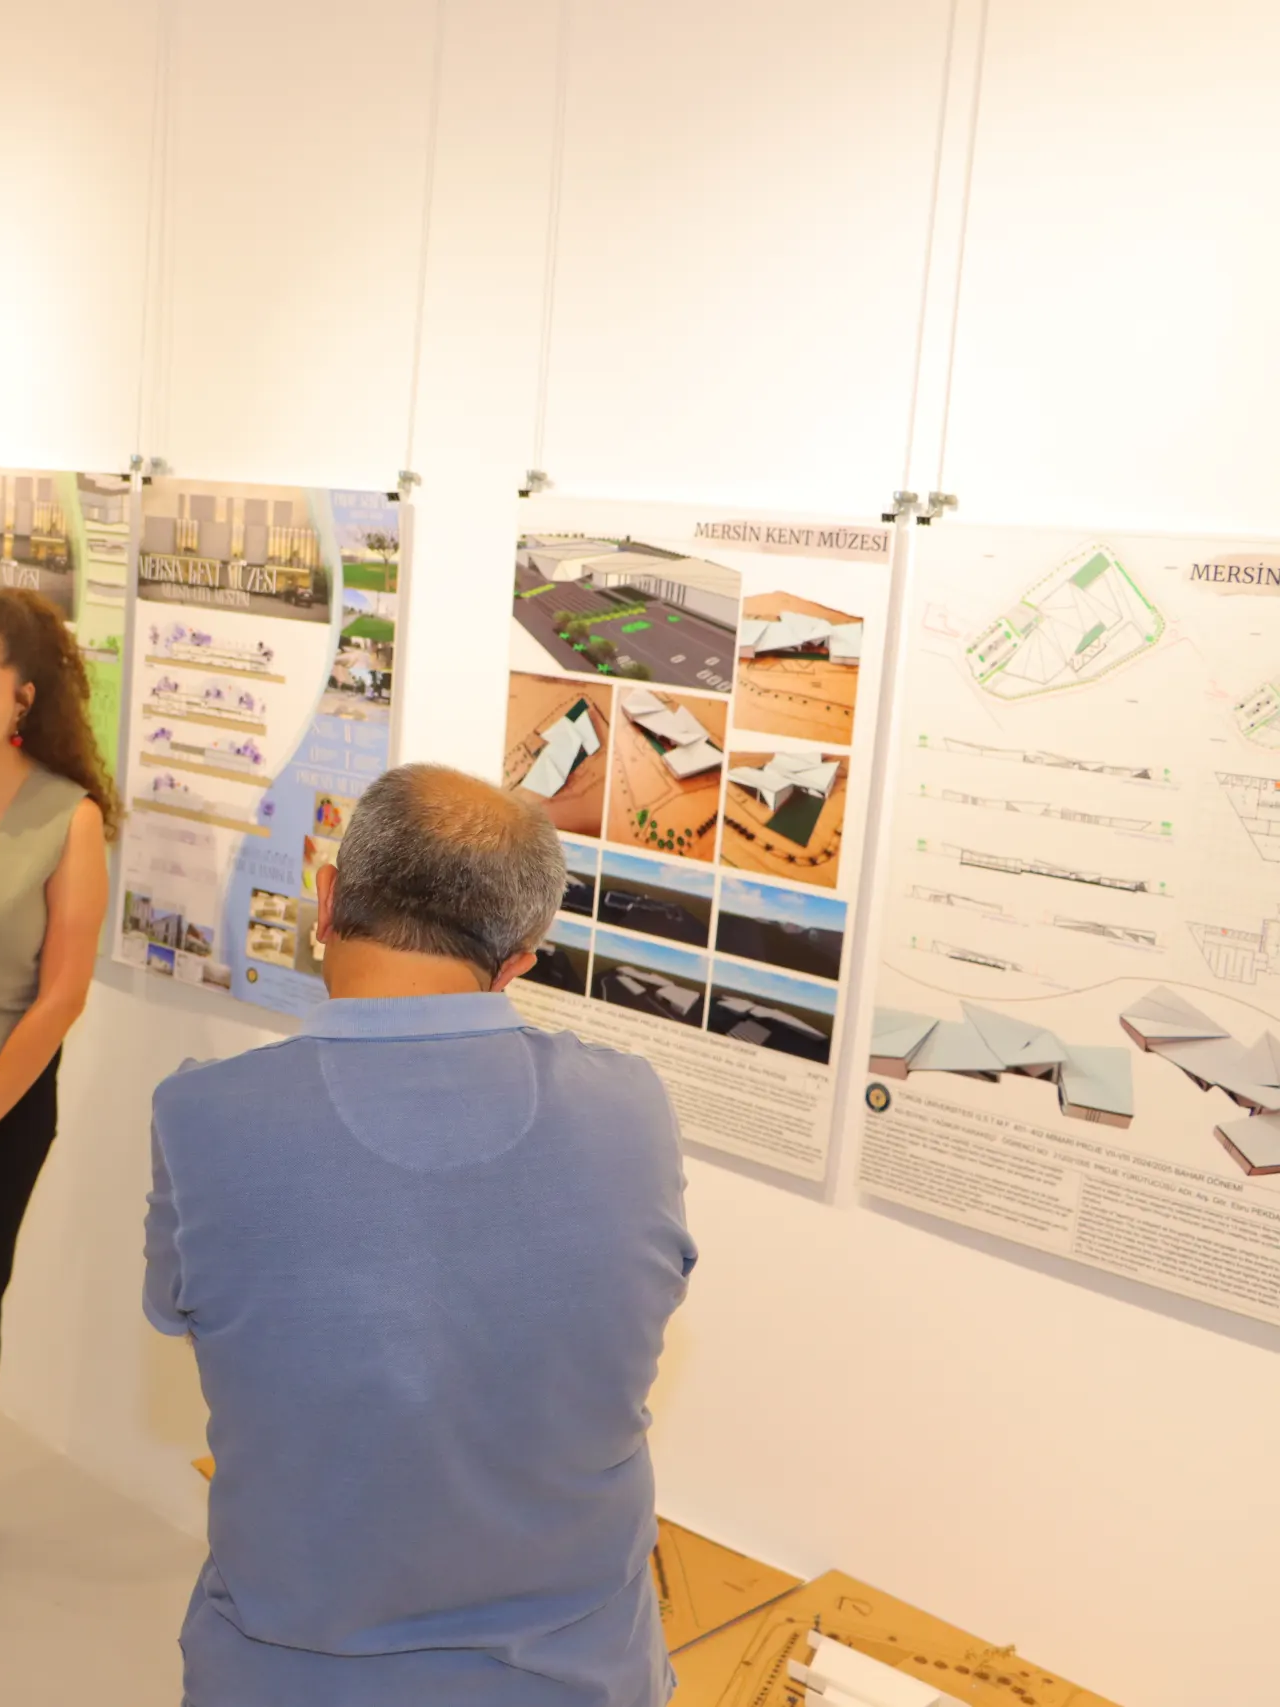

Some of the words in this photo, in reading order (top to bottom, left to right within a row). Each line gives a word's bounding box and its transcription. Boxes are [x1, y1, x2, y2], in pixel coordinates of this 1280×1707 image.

[694, 521, 762, 542] MERSİN
[765, 527, 814, 546] KENT
[817, 528, 889, 552] MÜZESİ
[1189, 562, 1280, 586] MERSİN
[1076, 1140, 1103, 1155] PROJE
[1174, 1168, 1205, 1182] BAHAR
[1206, 1174, 1244, 1192] DÖNEMİ
